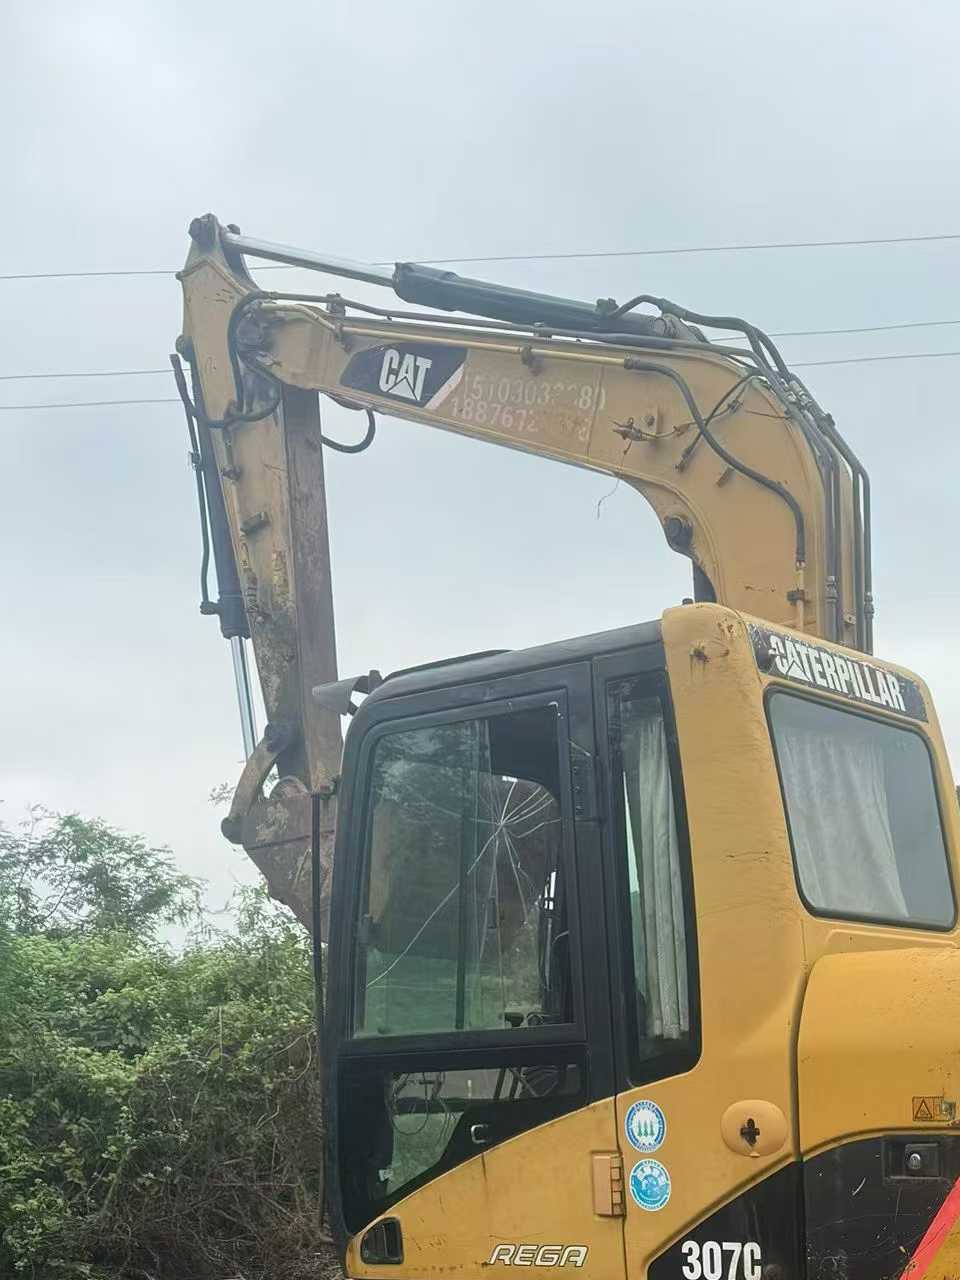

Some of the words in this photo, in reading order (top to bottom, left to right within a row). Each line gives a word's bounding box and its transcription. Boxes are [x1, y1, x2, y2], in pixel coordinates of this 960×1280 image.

[379, 349, 432, 400] CAT
[769, 635, 905, 711] CATERPILLAR
[488, 1244, 590, 1268] REGA
